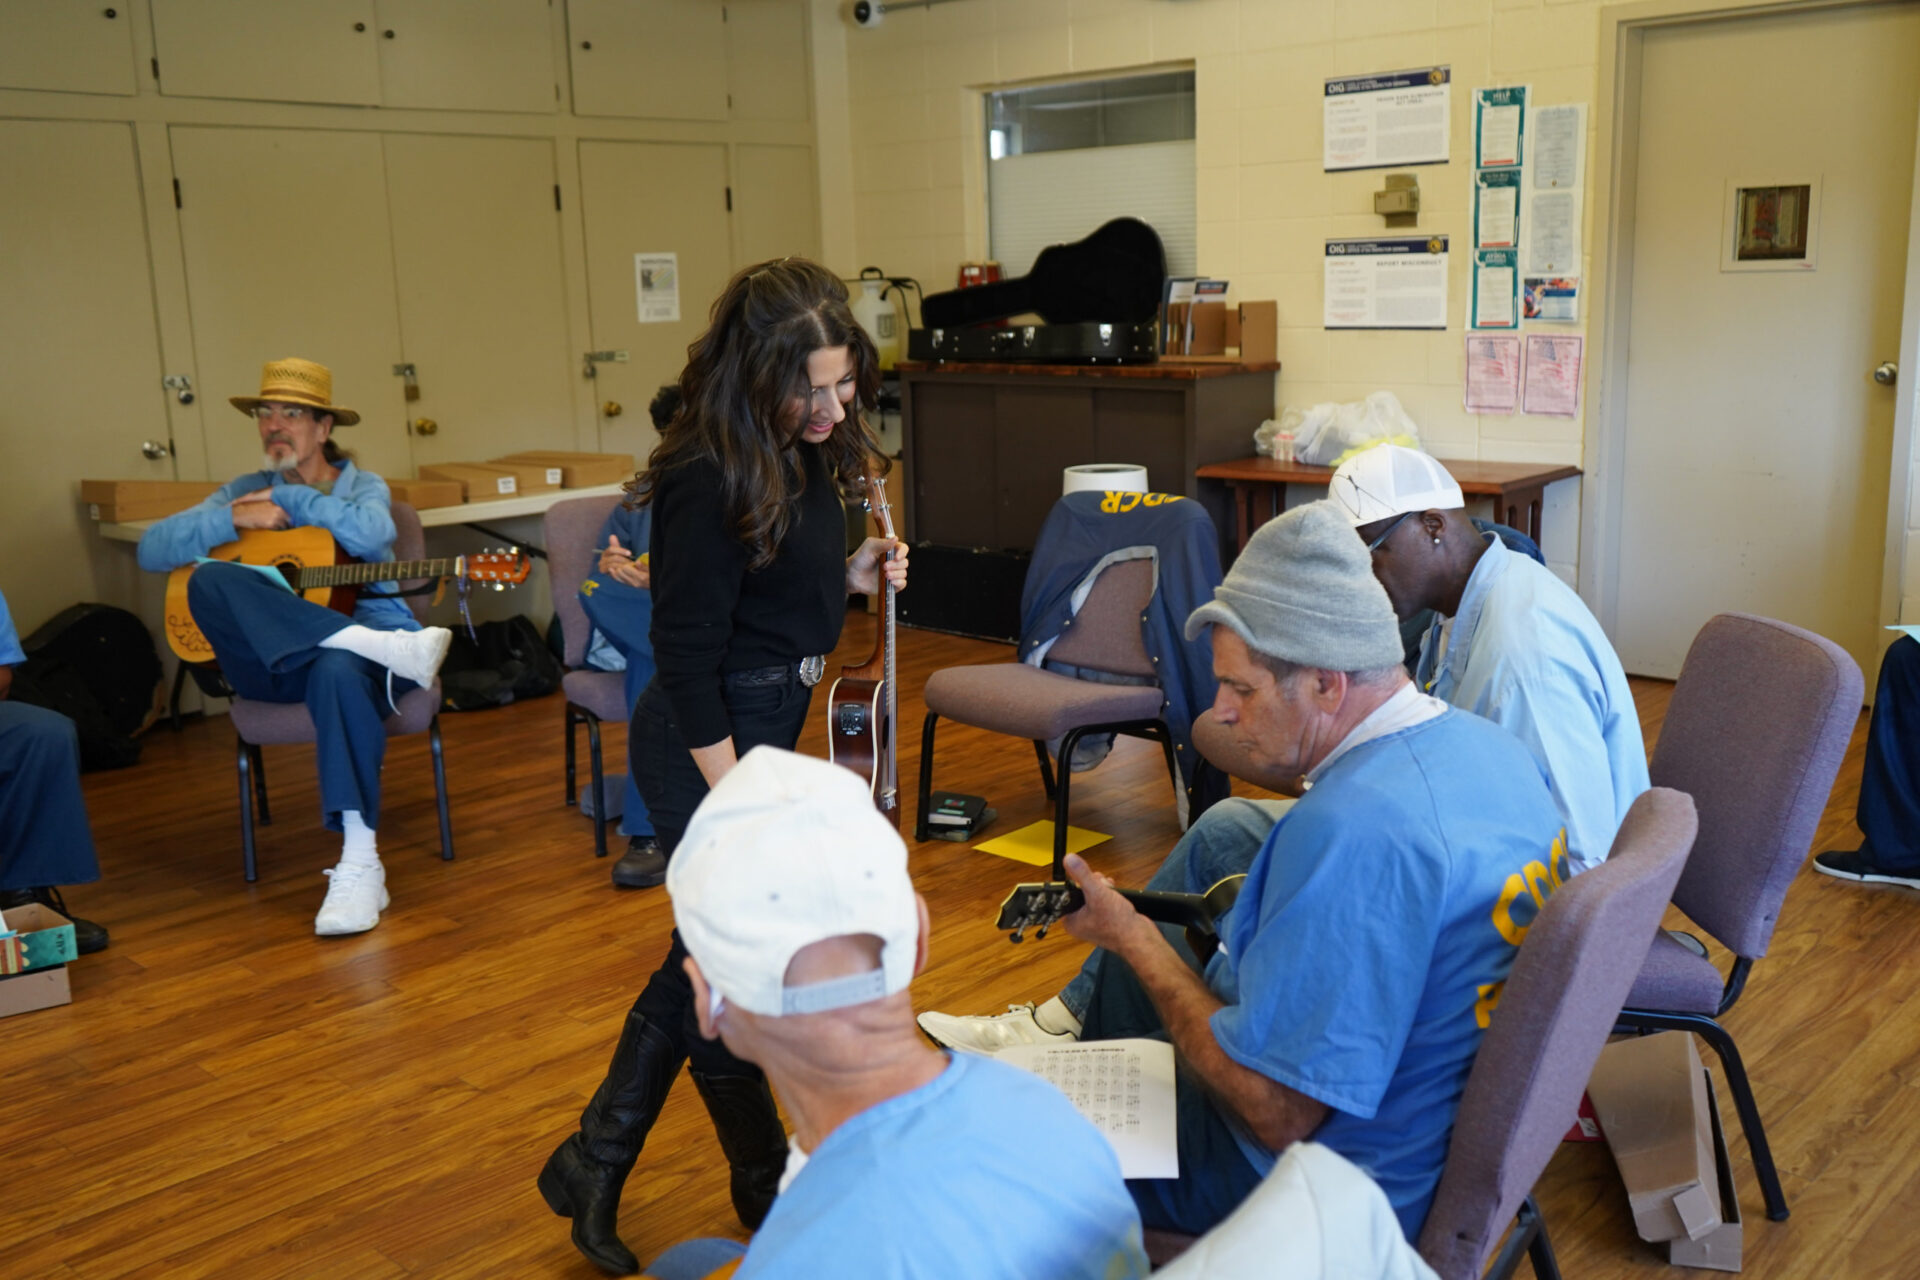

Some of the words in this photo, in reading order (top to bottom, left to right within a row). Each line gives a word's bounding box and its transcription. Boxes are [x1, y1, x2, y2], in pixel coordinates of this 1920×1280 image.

[1328, 82, 1344, 94] OIG
[1328, 244, 1345, 255] OIG
[1492, 826, 1570, 947] CDC
